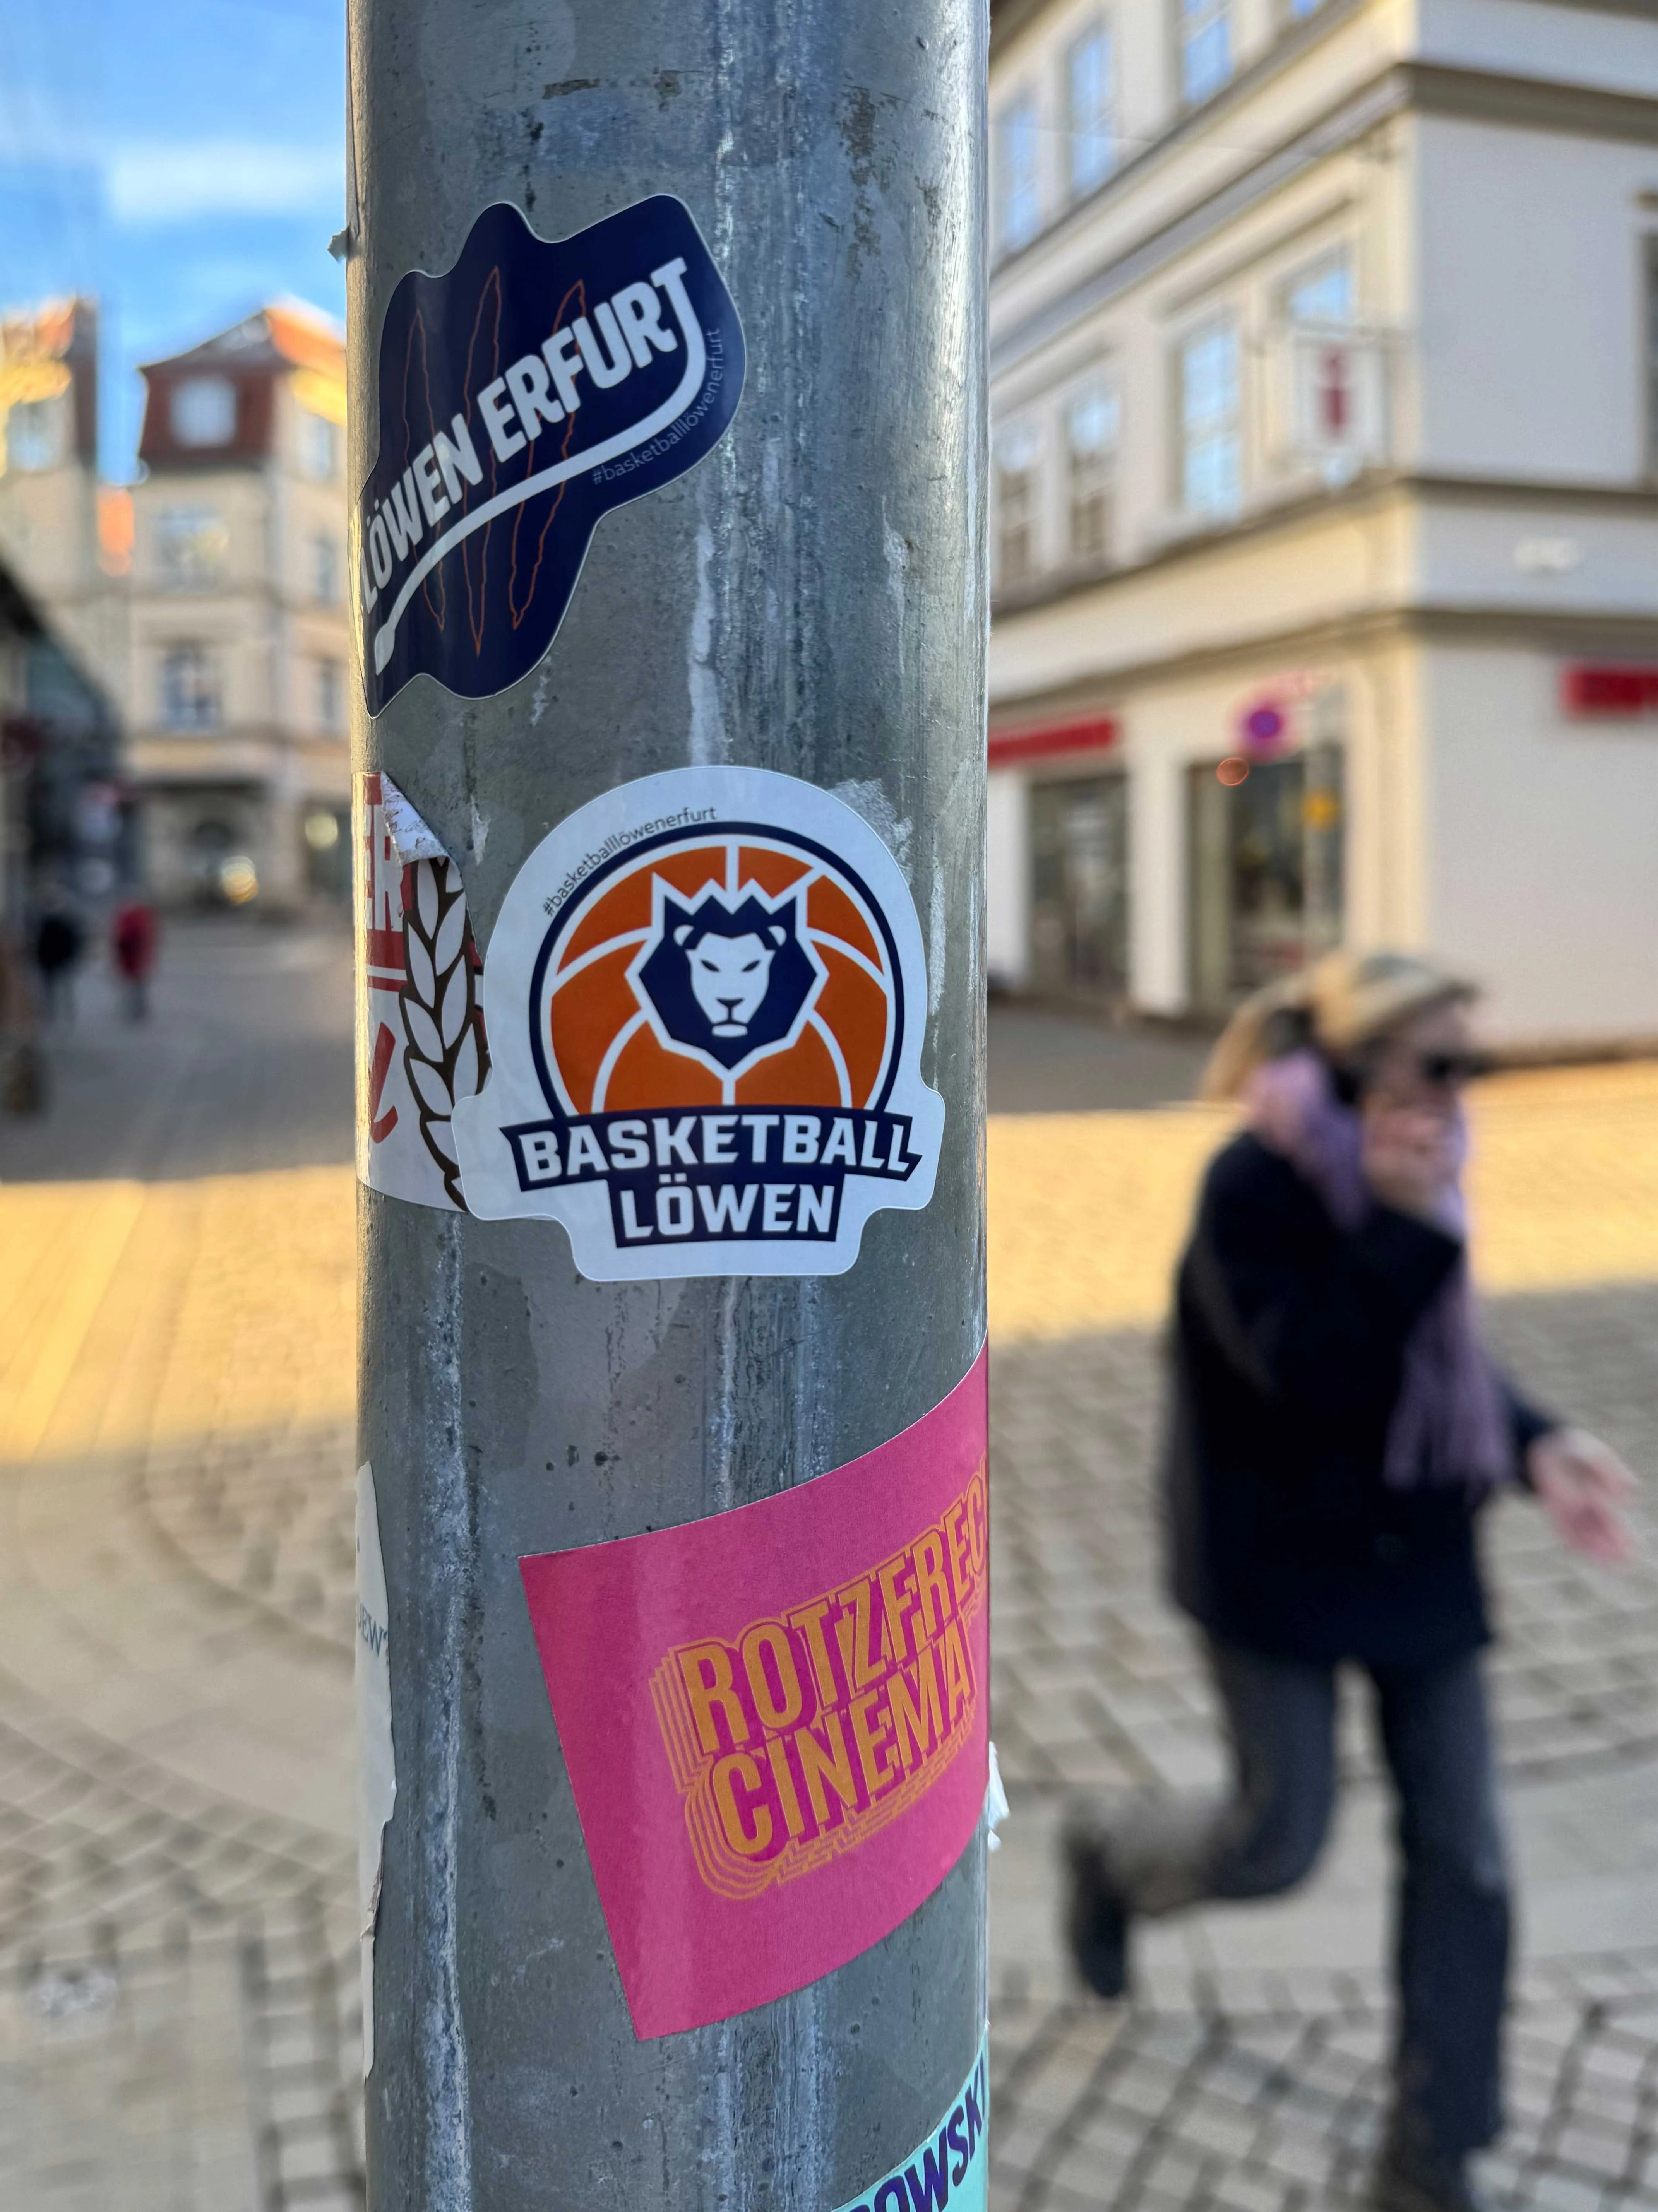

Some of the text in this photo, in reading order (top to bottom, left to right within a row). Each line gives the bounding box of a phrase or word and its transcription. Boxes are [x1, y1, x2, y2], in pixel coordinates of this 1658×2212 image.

[360, 257, 697, 614] LÖWEN ERFURT
[591, 327, 724, 485] #basketballlöwenerfurt
[543, 807, 718, 917] #basketballlöwenerfurt
[517, 1114, 916, 1181] BASKETBALL
[620, 1172, 835, 1238] LÖWEN
[671, 1457, 984, 1755] ROTZFREC
[709, 1617, 971, 1858] CINEMA
[847, 2052, 985, 2212] OWSKI
